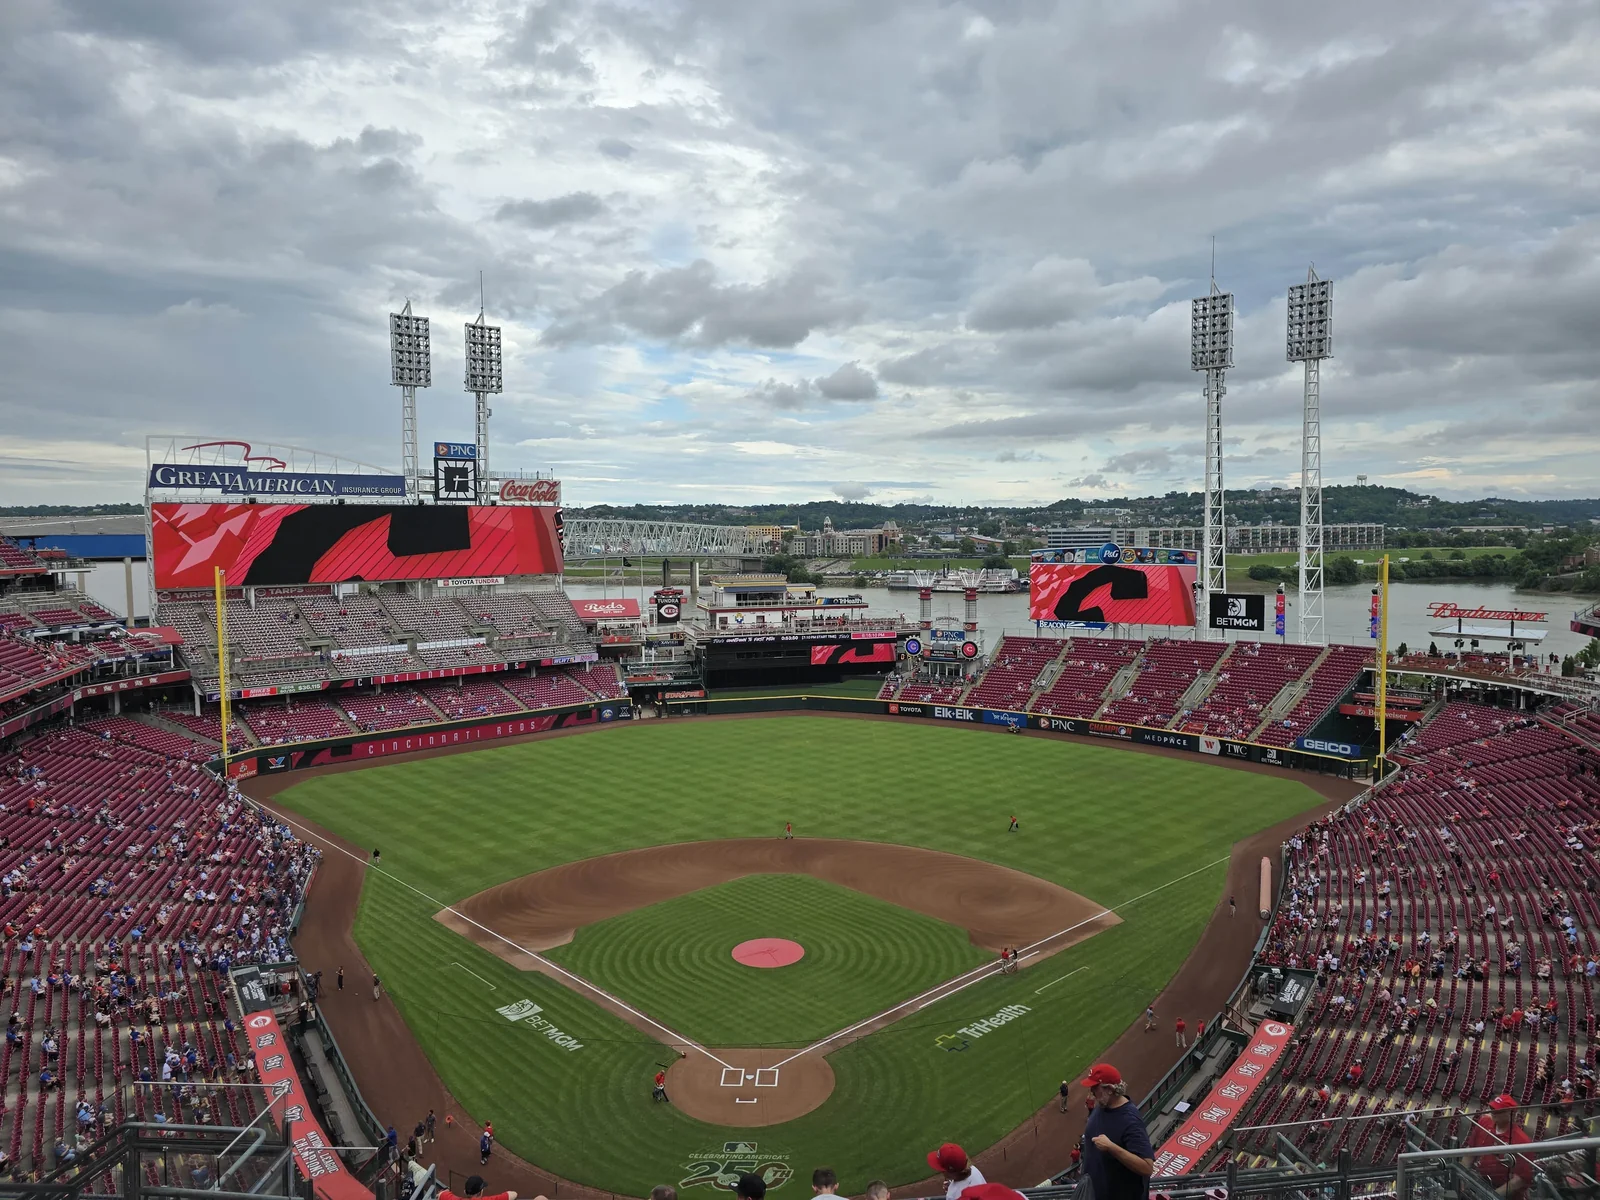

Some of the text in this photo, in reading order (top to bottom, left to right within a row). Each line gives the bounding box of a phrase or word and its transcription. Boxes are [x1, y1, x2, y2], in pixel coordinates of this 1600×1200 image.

[450, 445, 475, 456] PNC
[155, 466, 233, 486] GREAT
[228, 474, 336, 493] AMERICAN
[341, 486, 378, 494] INSURANCE
[500, 479, 560, 502] Coca-Cola
[1103, 550, 1119, 558] P&G
[174, 590, 213, 599] TARPS
[268, 586, 304, 595] TARPS
[583, 602, 626, 613] Reds
[1429, 602, 1545, 622] Budweiser
[1039, 620, 1067, 629] BEACON
[1216, 617, 1258, 628] BETMGM
[357, 661, 519, 688] CINCINNATI REDS
[900, 706, 922, 714] TOYOTA
[1051, 719, 1075, 732] PNC
[368, 720, 536, 755] CINCINNATI REDS
[1144, 734, 1188, 747] MEDPACE
[1225, 742, 1248, 755] TWC
[1303, 738, 1351, 755] GEICO
[956, 1003, 1033, 1039] TriHealth
[524, 1014, 585, 1053] BETMGM
[1202, 1106, 1227, 1123] 1940
[1180, 1130, 1207, 1147] 1919
[688, 1152, 790, 1161] CELEBRATING AMERICA'S
